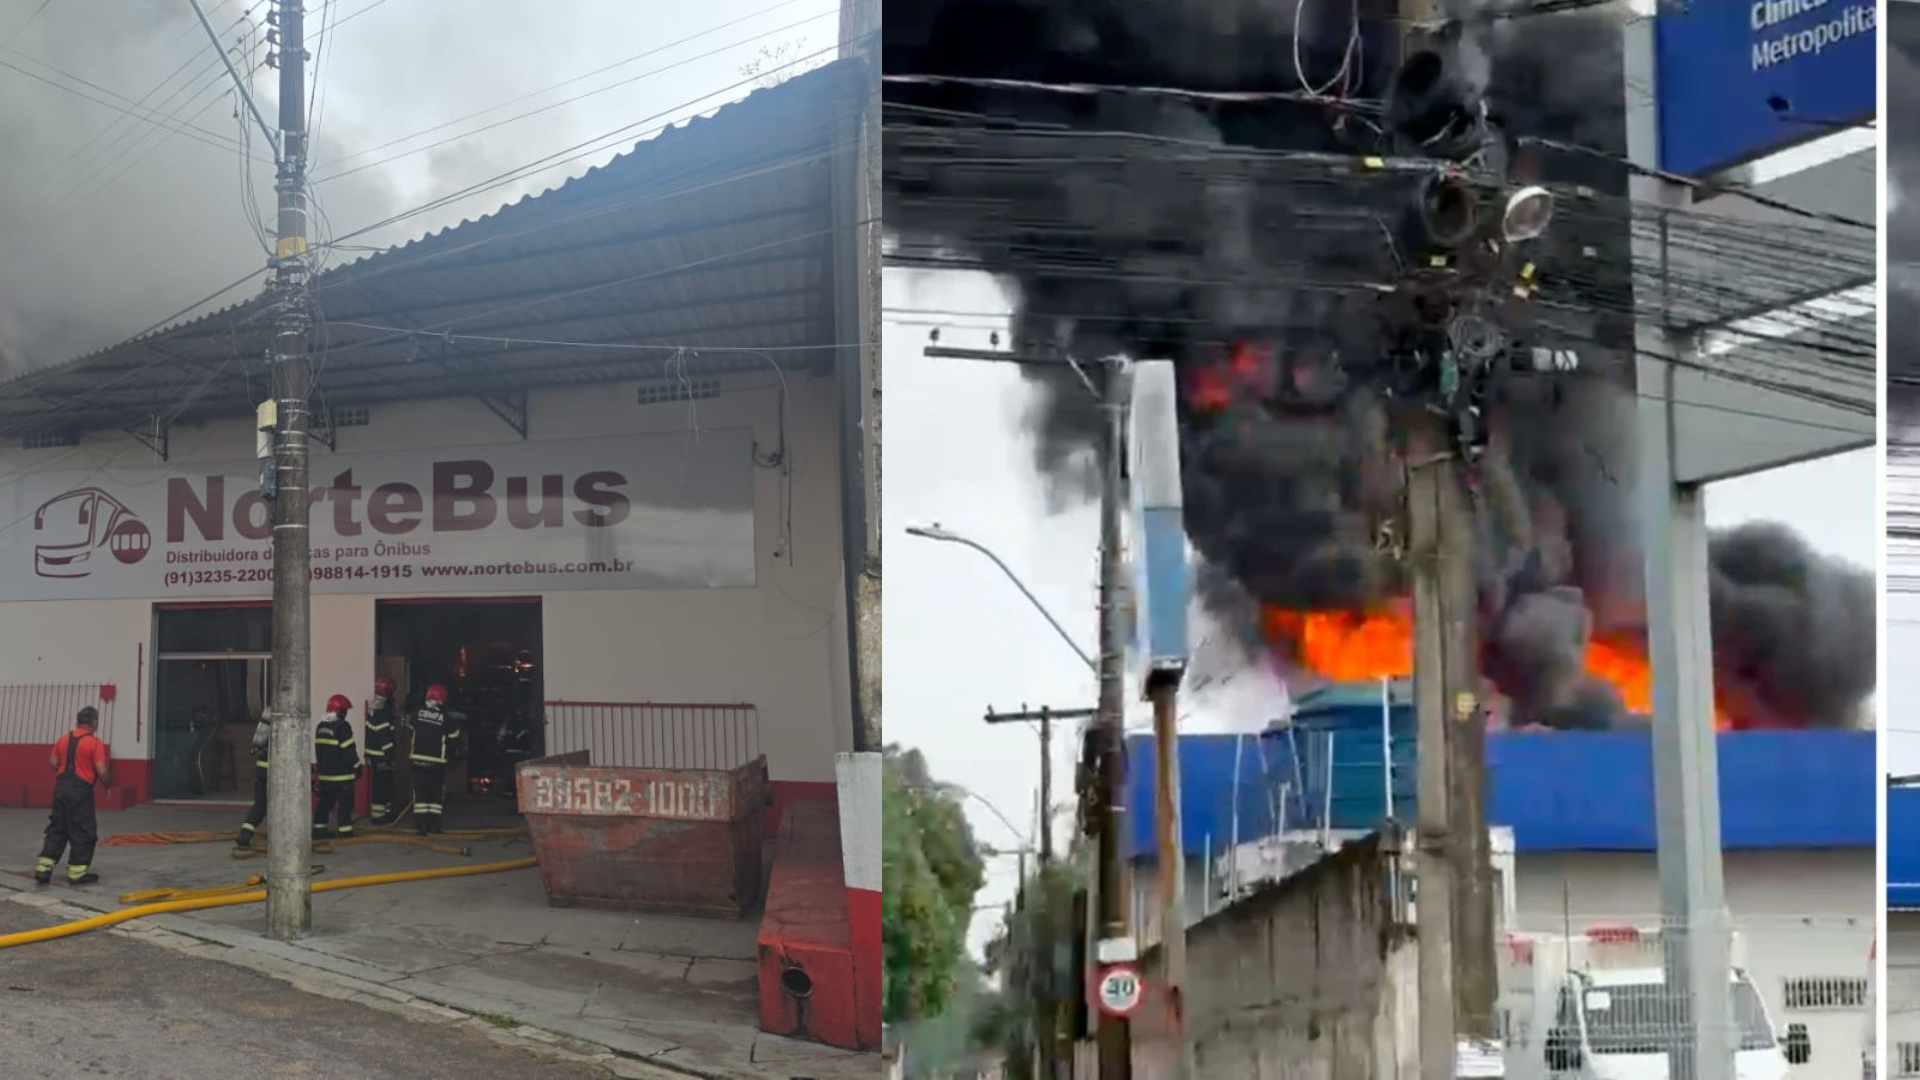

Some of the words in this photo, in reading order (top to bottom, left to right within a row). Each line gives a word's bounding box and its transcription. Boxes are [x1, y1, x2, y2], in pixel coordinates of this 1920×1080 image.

[166, 549, 259, 564] Distribuidora
[335, 546, 369, 561] para
[374, 540, 431, 557] Ônibus
[421, 558, 634, 577] www.nortebus.com.br
